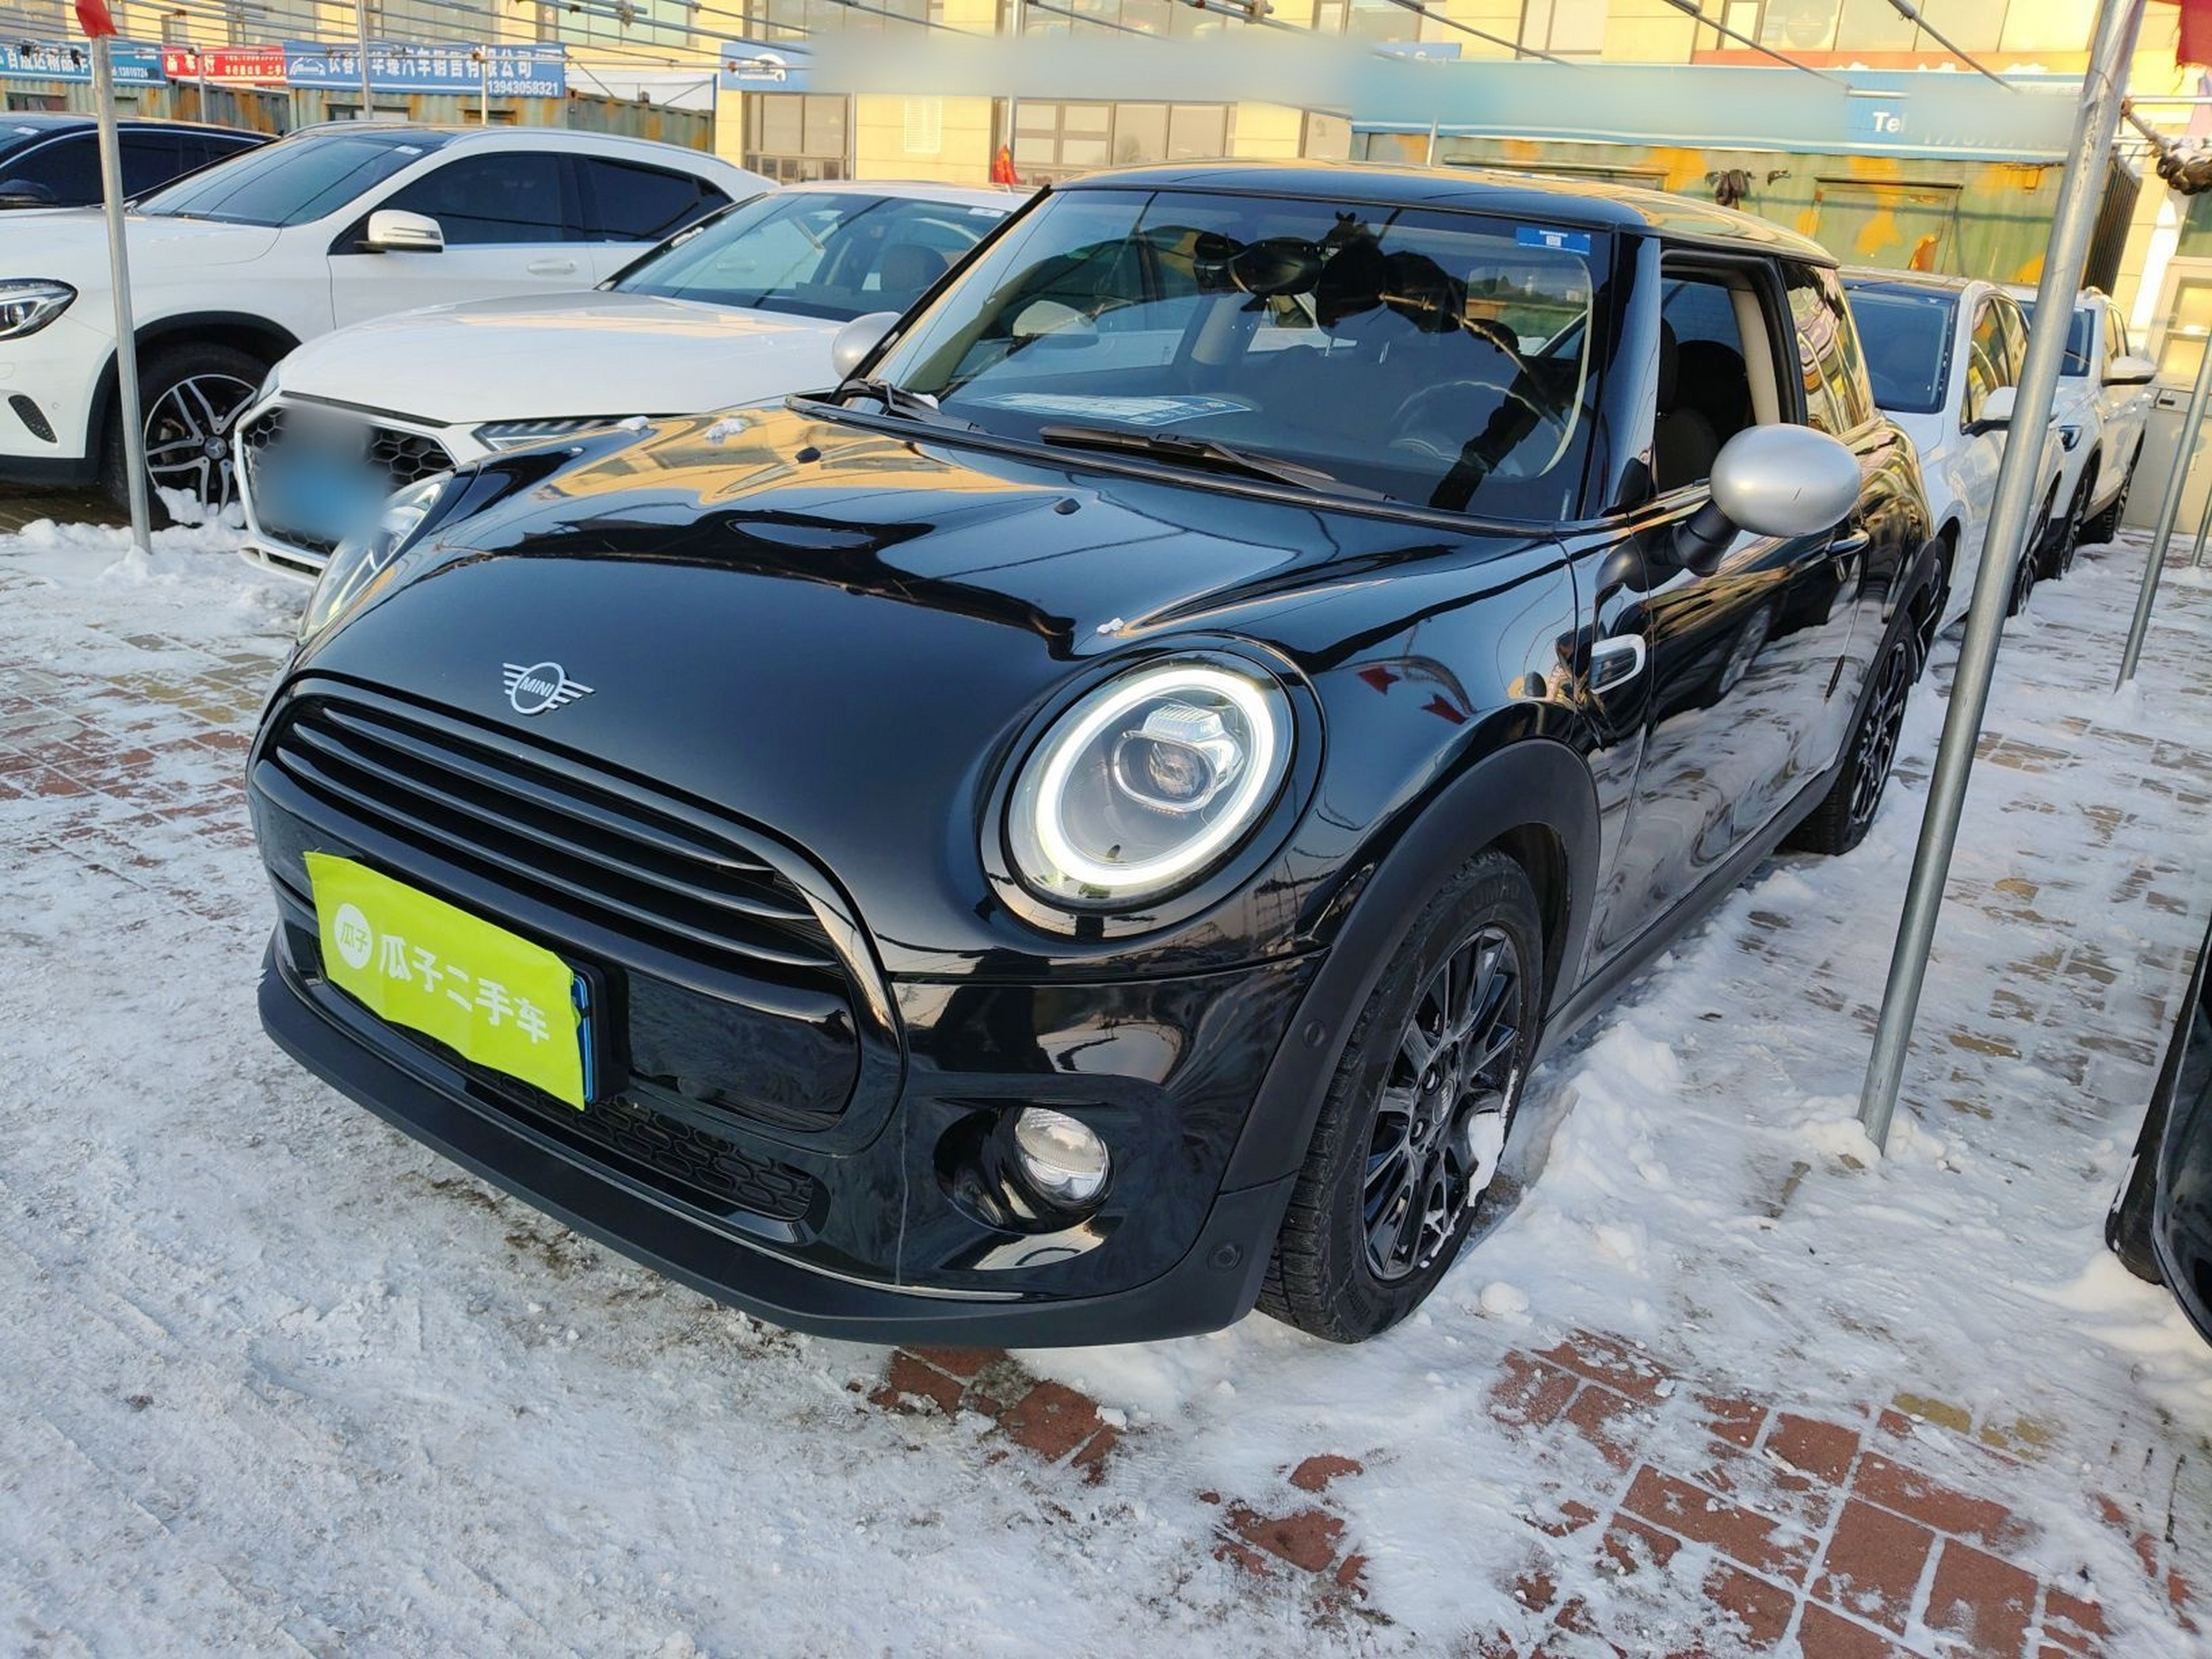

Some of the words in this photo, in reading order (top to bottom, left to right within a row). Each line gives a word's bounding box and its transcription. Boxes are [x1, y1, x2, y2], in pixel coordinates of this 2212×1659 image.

[519, 677, 555, 698] MINI
[340, 922, 368, 952] 瓜子
[378, 934, 550, 1044] 瓜子二手车
